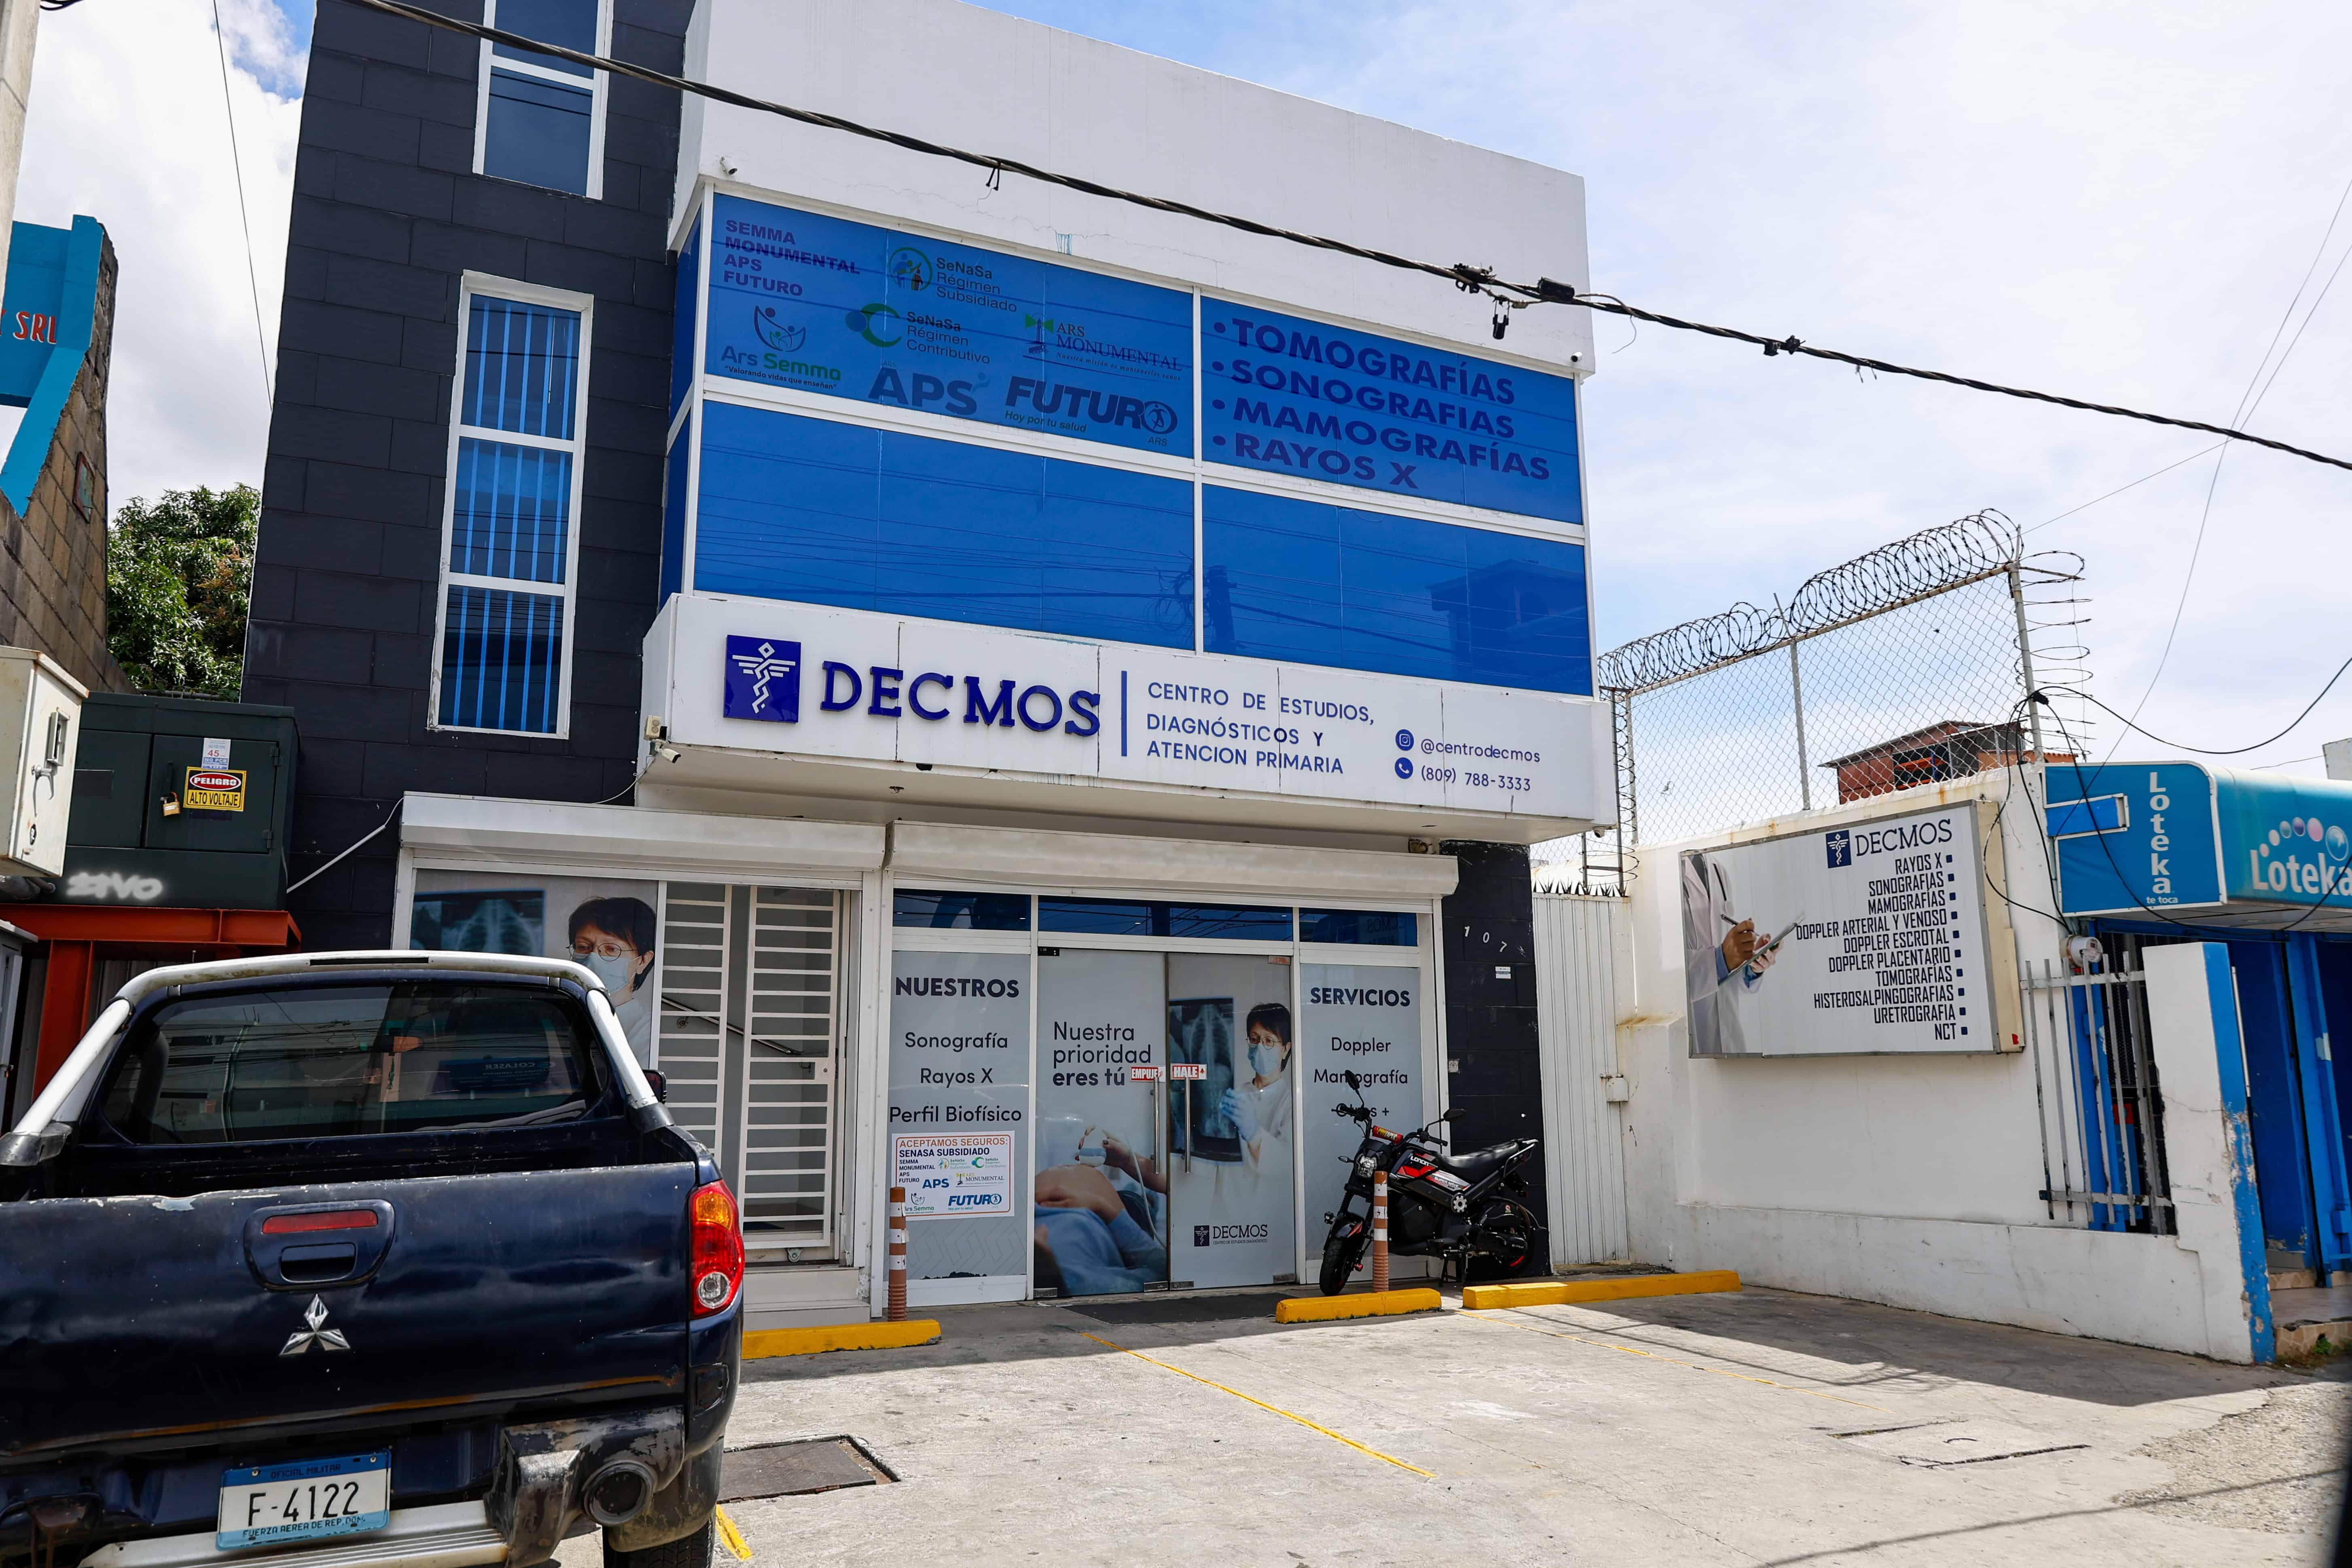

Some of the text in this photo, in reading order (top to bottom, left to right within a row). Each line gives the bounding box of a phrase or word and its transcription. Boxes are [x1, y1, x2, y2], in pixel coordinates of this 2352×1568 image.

[725, 220, 796, 245] SEMMA
[724, 253, 762, 271] APS
[725, 236, 860, 274] MONUMENTAL
[936, 257, 992, 280] SeNaSa
[724, 271, 803, 296] FUTURO
[937, 272, 1000, 295] Régimen
[936, 286, 1017, 311] Subsidiado
[13, 311, 57, 344] SRL
[907, 311, 961, 332] SeNaSa
[1057, 322, 1085, 337] ARS
[907, 325, 968, 347] Régimen
[721, 346, 841, 381] Ars Semma
[907, 340, 990, 364] Contributivo
[1056, 334, 1182, 371] MONUMENTAL
[1057, 352, 1083, 362] Nuestra
[1086, 358, 1108, 366] misión
[1232, 318, 1515, 405] TOMOGRAFÍAS
[868, 366, 977, 416] APS
[1231, 359, 1515, 439] SONOGRAFIAS
[1005, 376, 1178, 434] FUTURO
[1005, 410, 1087, 432] Hoy por tu salud
[1148, 436, 1168, 446] ARS
[1233, 398, 1550, 481] MAMOGRAFÍAS
[1235, 433, 1419, 489] RAYOS X
[820, 661, 1100, 737] DECMOS
[1148, 682, 1374, 725] CENTRO DE ESTUDIOS,
[1147, 714, 1323, 746] DIAGNÓSTICOS Y
[1147, 741, 1343, 774] ATENCION PRIMARIA
[1421, 739, 1540, 763] @centrodecmos
[194, 778, 237, 786] PELIGRO
[1421, 765, 1531, 791] (809) 788-3333
[189, 792, 238, 806] ALTO VOLTAJE
[1855, 819, 1952, 857] DECMOS
[2149, 771, 2171, 894] Loteka
[1895, 852, 1942, 875] RAYOS X
[2250, 850, 2352, 896] Loteka
[1869, 871, 1943, 896] SONOGRAFIAS
[1868, 887, 1945, 915] MAMOGRAFÍAS
[1796, 909, 1947, 940] DOPPLER ARTERIAL Y VENOSO
[1844, 928, 1949, 953] DOPPLER ESCROTAL
[1829, 947, 1950, 973] DOPPLER PLACENTARIO
[1875, 963, 1952, 987] TOMOGRAFÍAS
[896, 977, 1019, 998] NUESTROS
[1310, 987, 1410, 1006] SERVICIOS
[1814, 985, 1954, 1009] HISTEROSALPINGOGRAFIAS
[1874, 1004, 1956, 1023] URETROGRAFIA
[905, 1032, 1008, 1052] Sonografía
[1054, 1021, 1134, 1041] Nuestra
[1935, 1023, 1956, 1040] NCT
[1053, 1044, 1151, 1069] prioridad
[1332, 1037, 1391, 1055] Doppler
[920, 1068, 993, 1088] Rayos X
[1053, 1067, 1125, 1086] eres tú
[1132, 1068, 1158, 1079] EMPUJE
[1174, 1066, 1198, 1077] HALE
[890, 1105, 1021, 1123] Perfil Biofísico
[899, 1147, 990, 1157] SENASA SUBSIDIADO
[900, 1138, 1008, 1148] ACEPTAMOS SEGUROS:
[922, 1178, 949, 1189] APS
[948, 1194, 1002, 1206] FUTURO
[1213, 1224, 1268, 1239] DECMOS
[271, 1464, 341, 1479] OFICIAL MILITAR
[248, 1481, 359, 1527] F-4122
[243, 1527, 277, 1537] FUERZA
[280, 1522, 309, 1532] AEREA
[311, 1520, 323, 1529] DE
